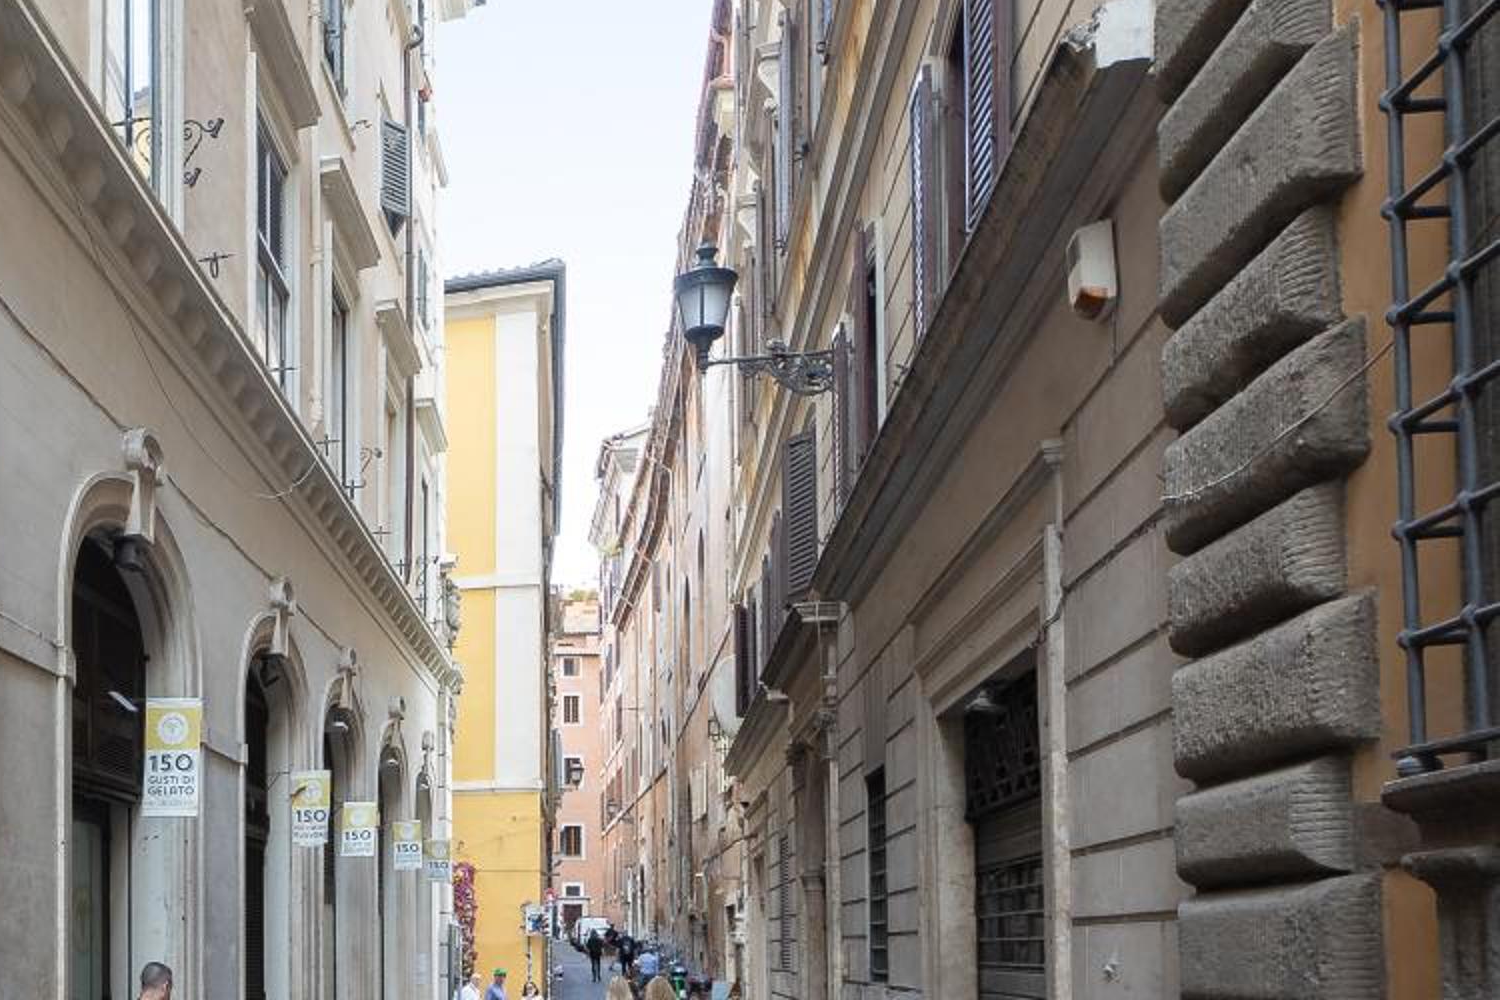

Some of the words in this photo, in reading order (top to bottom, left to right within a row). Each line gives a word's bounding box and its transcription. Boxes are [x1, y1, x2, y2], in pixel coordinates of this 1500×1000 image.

[149, 753, 193, 772] 150
[148, 775, 179, 785] GUSTI
[182, 775, 195, 785] DI
[147, 785, 195, 797] GELATO
[296, 809, 327, 823] 150
[345, 829, 371, 841] 150
